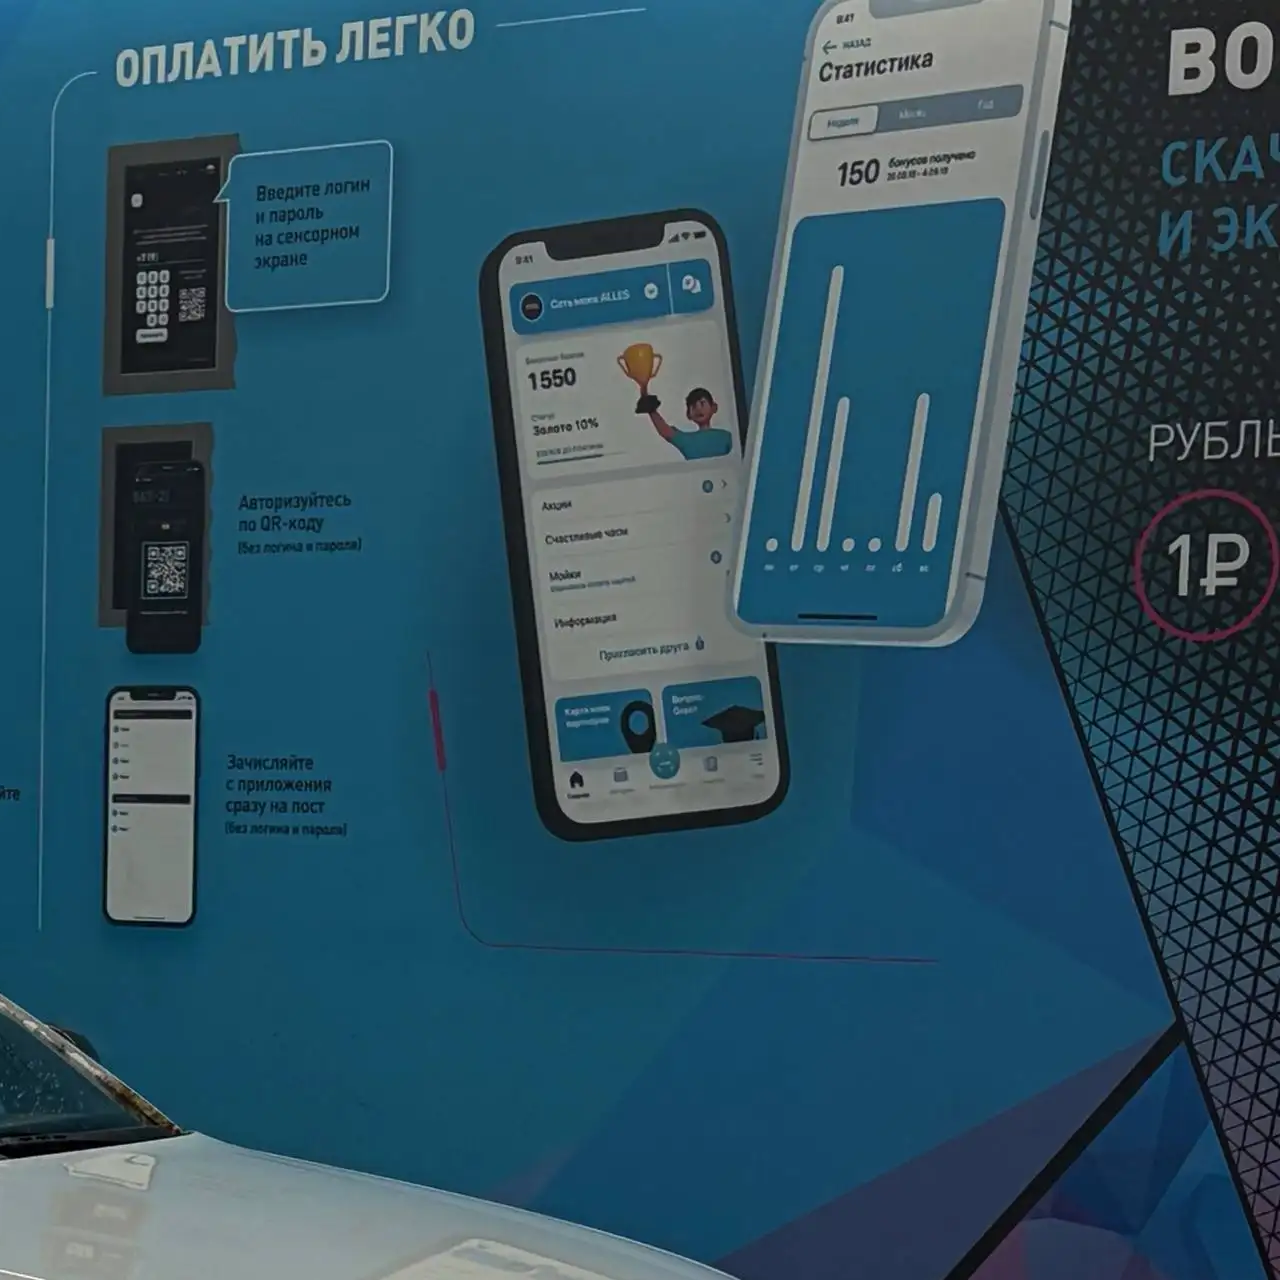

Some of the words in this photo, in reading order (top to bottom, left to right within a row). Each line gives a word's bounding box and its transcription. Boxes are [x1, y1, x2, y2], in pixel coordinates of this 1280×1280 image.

[115, 26, 328, 88] ОПЛАТИТЬ
[335, 8, 475, 64] ЛЕГКО
[1168, 20, 1274, 97] ВО
[819, 51, 933, 82] Статистика
[838, 159, 880, 186] 150
[256, 182, 321, 203] Введите
[323, 178, 370, 197] логин
[256, 211, 265, 224] и
[269, 205, 324, 227] пароль
[255, 233, 273, 247] на
[276, 226, 360, 245] сенсорном
[1158, 209, 1193, 262] И
[254, 252, 308, 270] экране
[528, 367, 576, 390] 1550
[576, 418, 599, 430] 10%
[238, 493, 351, 513] Авторизуйтесь
[239, 518, 257, 533] по
[259, 514, 324, 535] QR-коду
[237, 539, 261, 556] (без
[263, 540, 301, 555] логина
[315, 537, 362, 554] пароля)
[226, 754, 314, 772] Зачисляйте
[225, 779, 233, 791] с
[237, 778, 332, 796] приложения
[225, 801, 266, 818] сразу
[269, 801, 287, 813] на
[291, 799, 324, 814] пост
[225, 822, 247, 837] (без
[250, 823, 288, 837] логина
[301, 822, 347, 837] пароля)
